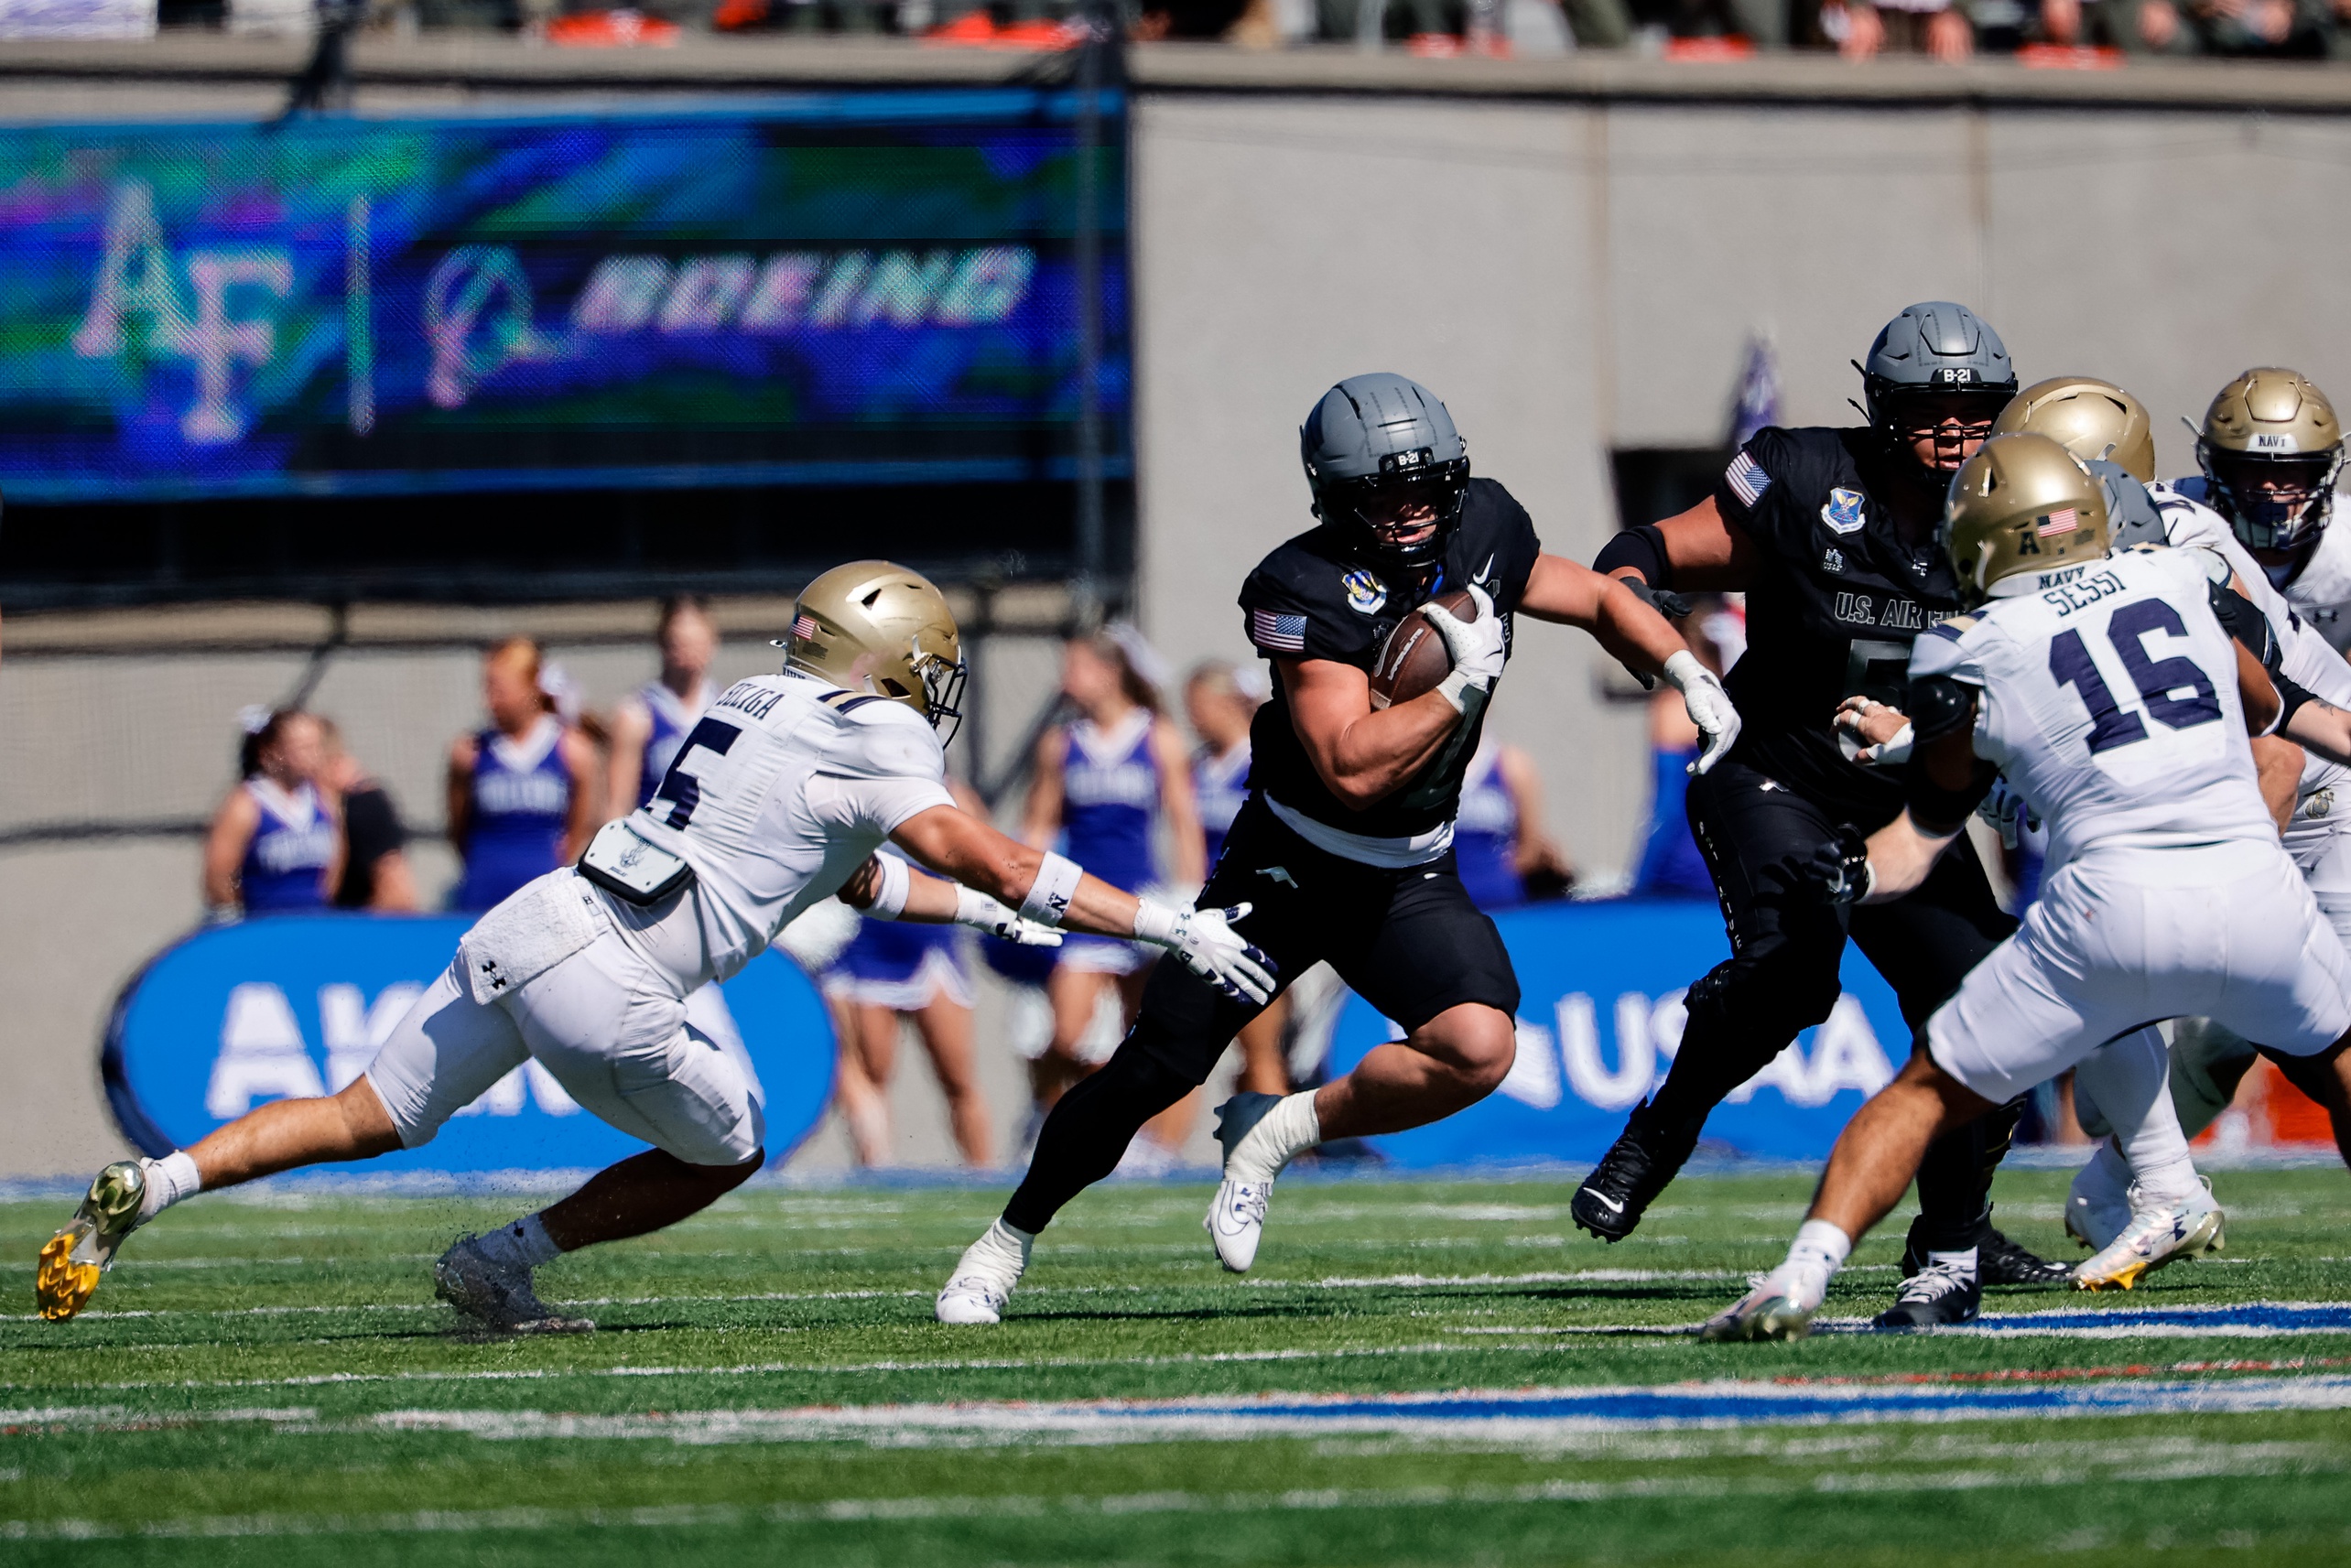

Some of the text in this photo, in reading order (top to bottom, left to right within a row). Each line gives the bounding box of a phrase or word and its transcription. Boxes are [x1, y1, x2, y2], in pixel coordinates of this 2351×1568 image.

[75, 179, 295, 446] AF
[571, 245, 1036, 336] BOEING
[1944, 369, 1971, 383] B-21
[1398, 451, 1420, 466] B-21
[2038, 566, 2086, 590] NAVY
[2042, 570, 2127, 617] SESSI
[1835, 591, 1876, 625] U.S.
[1880, 599, 1923, 630] AIR
[2048, 597, 2224, 756] 16
[645, 716, 744, 833] 5
